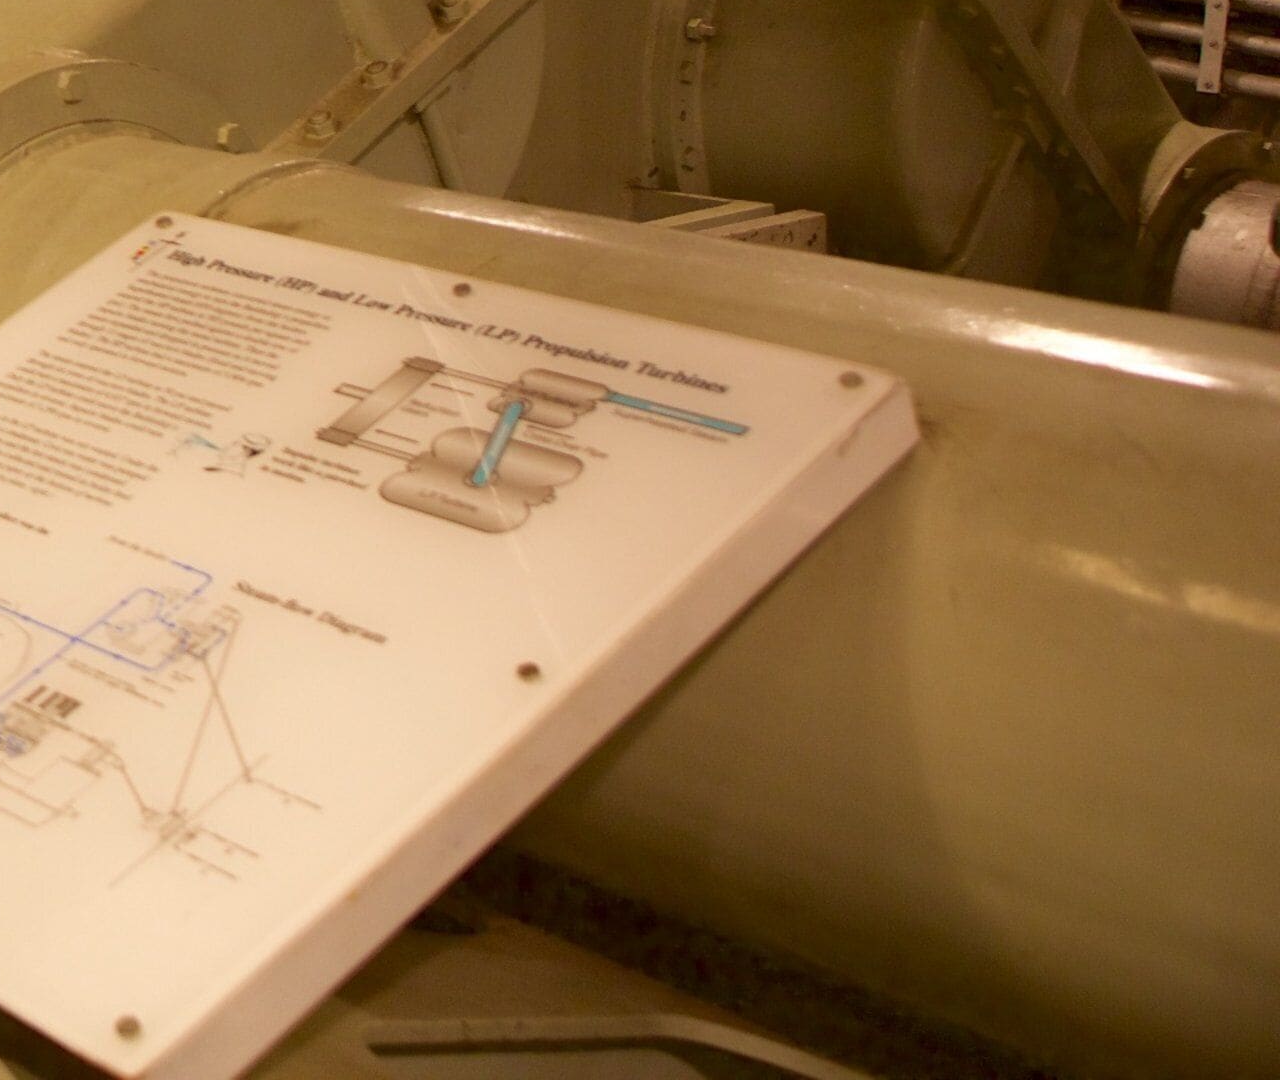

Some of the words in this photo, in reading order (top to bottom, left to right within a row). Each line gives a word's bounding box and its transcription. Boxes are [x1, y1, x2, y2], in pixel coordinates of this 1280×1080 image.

[168, 250, 206, 267] High
[207, 258, 275, 283] Pressure
[275, 275, 319, 295] (HP)
[318, 287, 355, 301] and
[353, 293, 393, 311] Low
[393, 303, 473, 332] Pressure
[474, 323, 522, 344] (LP)
[522, 334, 630, 371] Propulsion
[636, 360, 729, 394] Turbines
